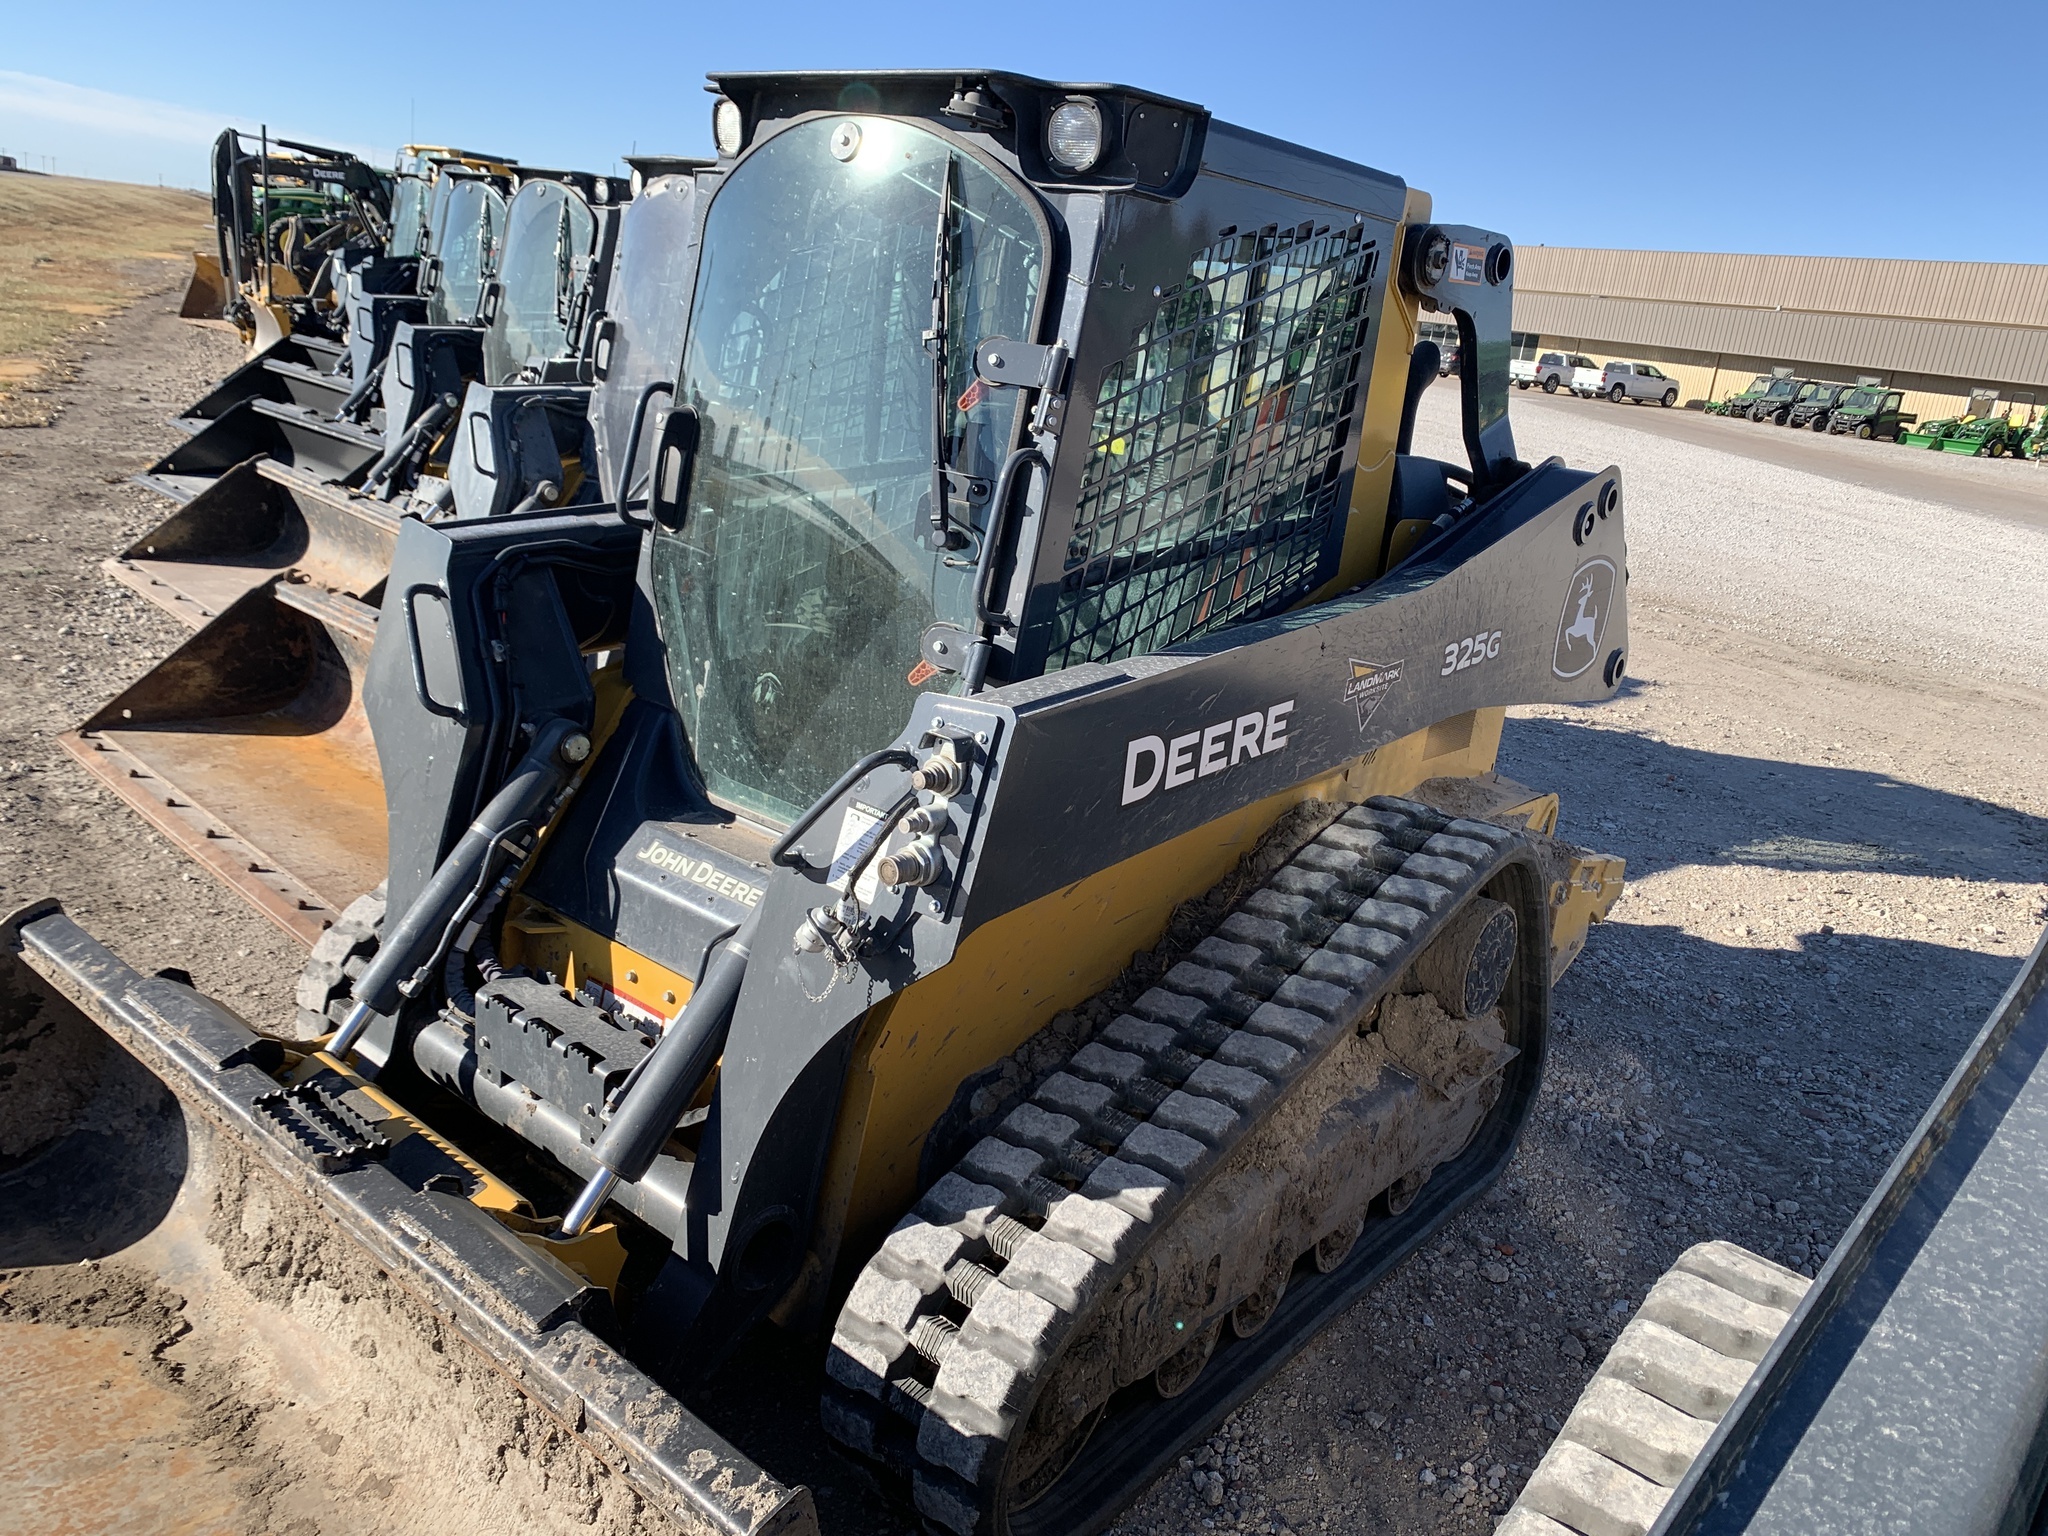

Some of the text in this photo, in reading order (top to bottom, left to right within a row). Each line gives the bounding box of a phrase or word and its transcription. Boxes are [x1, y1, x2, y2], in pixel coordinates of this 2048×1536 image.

[312, 168, 346, 180] DEERE
[1441, 631, 1502, 676] 325G
[1347, 667, 1401, 695] LANDMARK
[1359, 682, 1389, 699] WORKSITE
[1121, 699, 1295, 807] DEERE
[855, 801, 889, 820] IMPORTANT
[638, 840, 764, 908] JOHN DEERE
